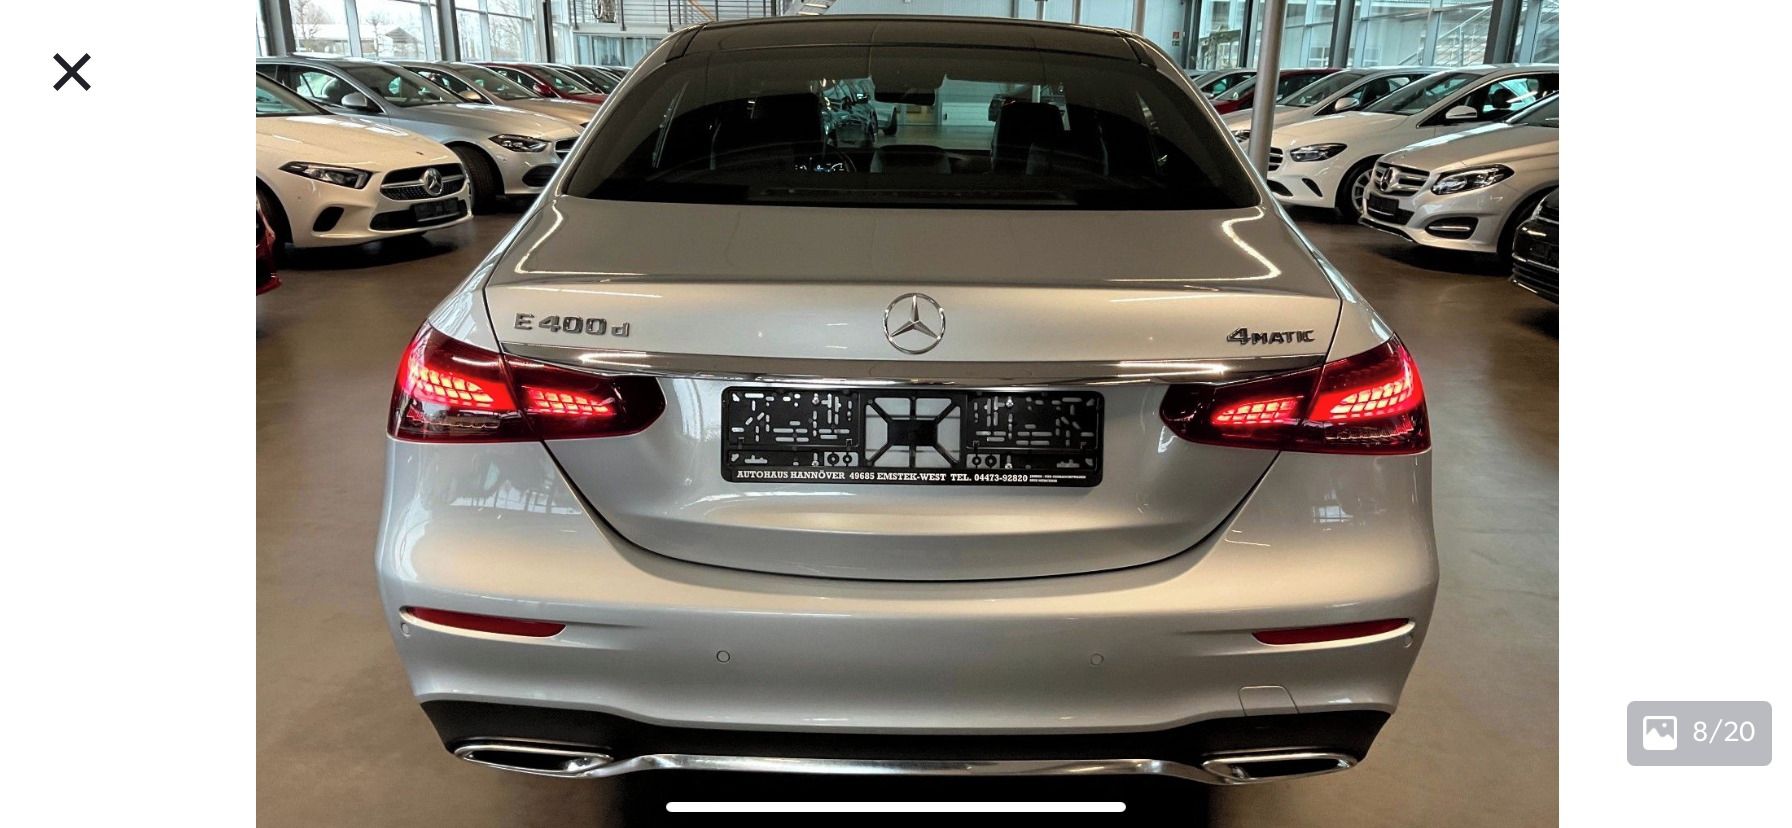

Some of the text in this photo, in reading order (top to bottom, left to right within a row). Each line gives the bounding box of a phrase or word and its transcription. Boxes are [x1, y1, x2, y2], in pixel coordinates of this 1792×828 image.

[514, 312, 535, 330] E
[1226, 327, 1316, 346] 4MATIC
[736, 470, 789, 479] AUTOHAUS
[849, 472, 875, 480] 49685
[876, 472, 946, 481] EMSTEK-WEST
[950, 473, 972, 481] TEL.
[974, 473, 1028, 482] 04473-92820
